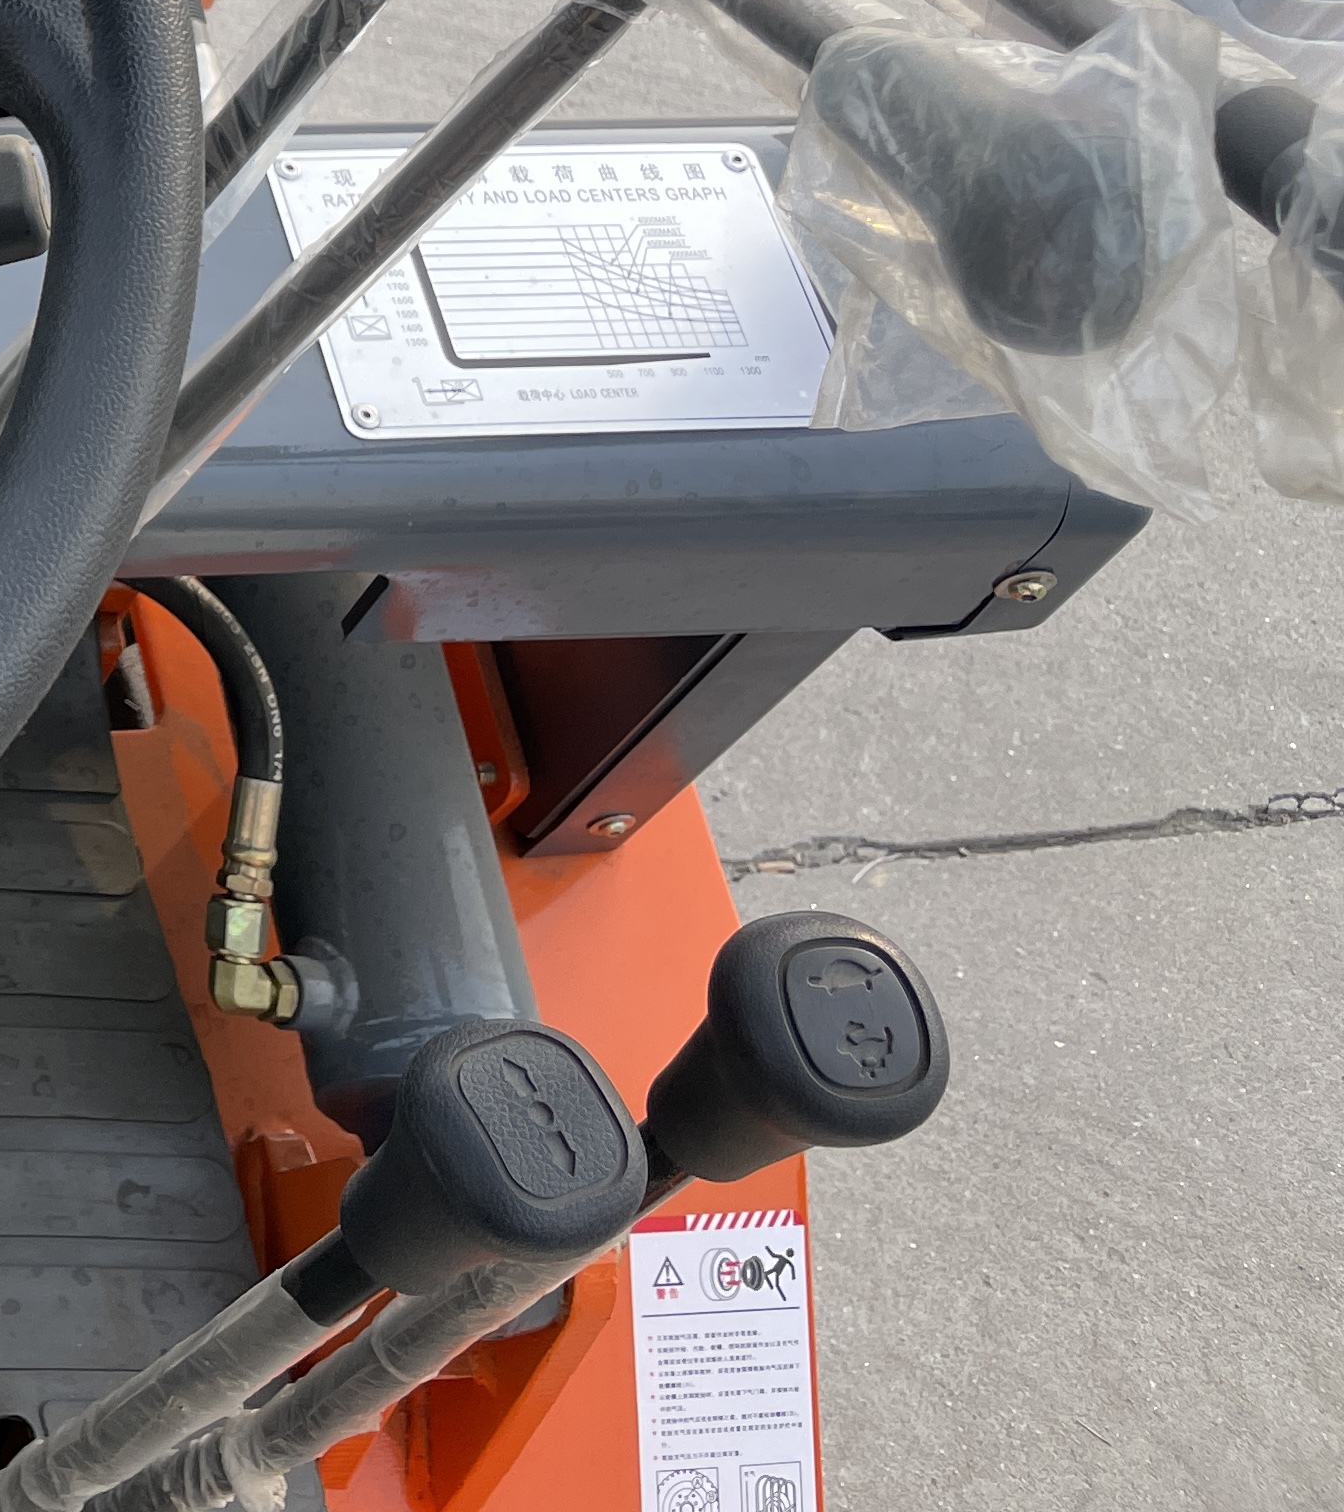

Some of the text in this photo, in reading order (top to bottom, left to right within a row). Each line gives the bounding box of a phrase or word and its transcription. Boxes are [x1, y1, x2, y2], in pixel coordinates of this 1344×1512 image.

[483, 190, 519, 205] AND
[526, 188, 572, 204] LOAD
[577, 187, 660, 203] CENTERS
[666, 186, 728, 201] GRAPH
[387, 282, 410, 291] 1700
[391, 296, 414, 305] 1600
[396, 309, 419, 318] 1500
[400, 323, 423, 332] 1400
[405, 338, 428, 347] 1300
[606, 369, 624, 378] 500
[637, 368, 655, 377] 700
[703, 367, 725, 376] 1100
[740, 366, 762, 375] 1300
[570, 387, 639, 399] LOAD CENTER
